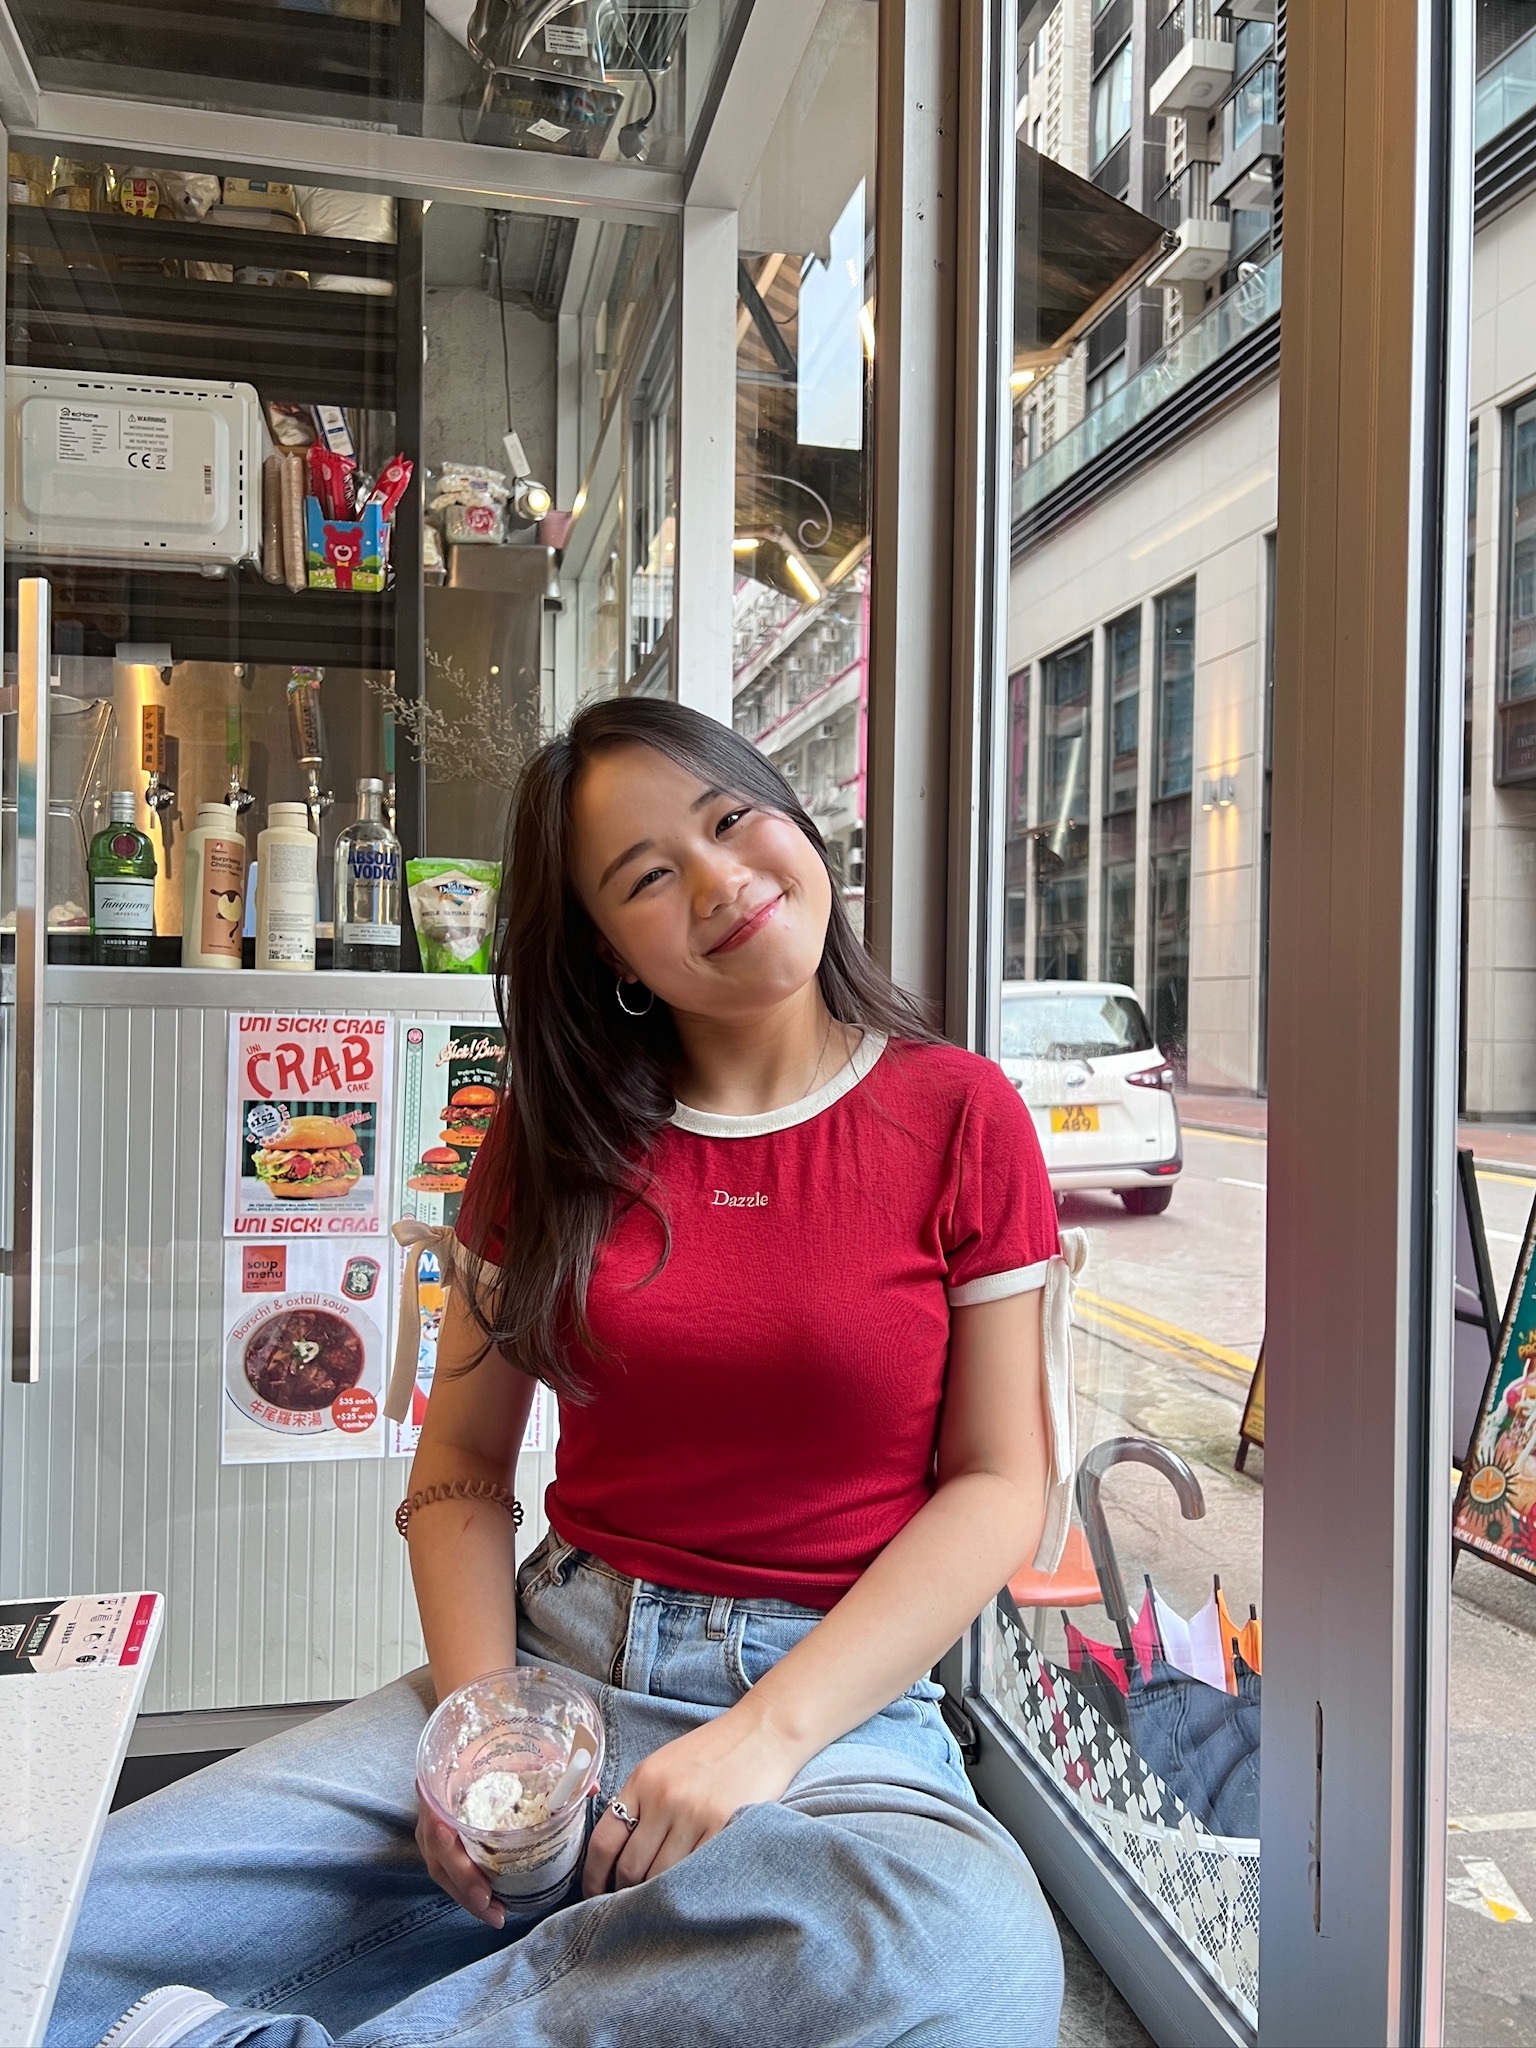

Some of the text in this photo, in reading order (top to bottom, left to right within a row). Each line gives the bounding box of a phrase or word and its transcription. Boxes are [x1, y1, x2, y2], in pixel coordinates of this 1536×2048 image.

[353, 864, 398, 881] VODKA
[103, 938, 126, 946] LONDON
[239, 1016, 272, 1032] UNI
[276, 1018, 329, 1034] SICK!
[246, 1043, 262, 1055] UNI
[246, 1034, 374, 1099] CRAB
[347, 1082, 370, 1093] CAKE
[250, 1112, 275, 1129] $152
[1062, 1118, 1092, 1132] 489
[711, 1189, 769, 1207] Dazzle
[234, 1217, 267, 1233] UNI
[271, 1217, 323, 1233] SICK!
[247, 1260, 278, 1271] soup
[247, 1270, 283, 1279] menu
[233, 1294, 350, 1340] Borscht & oxtail soup
[339, 1397, 374, 1406] $35 each
[250, 1399, 323, 1428] 牛尾羅宋湯
[358, 1411, 376, 1420] with
[342, 1421, 369, 1429] combo
[1474, 1536, 1509, 1561] BURGER
[1511, 1552, 1535, 1572] SICK!
